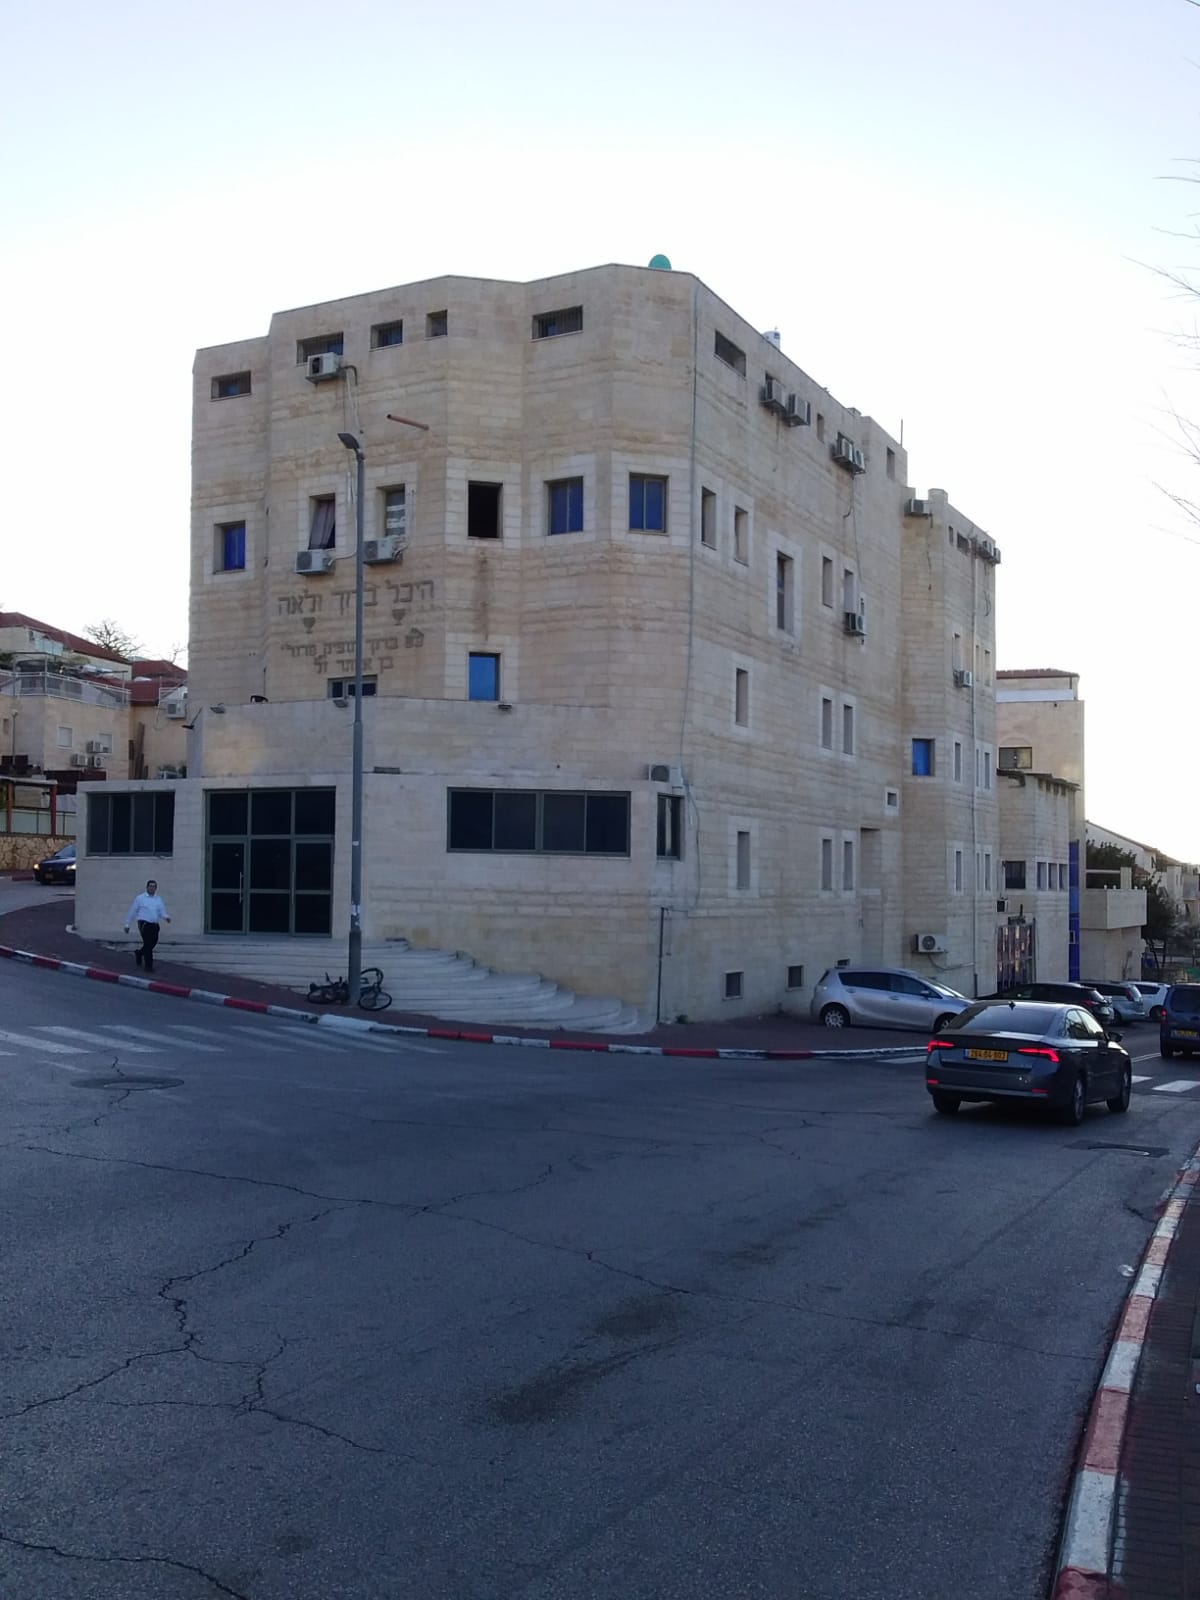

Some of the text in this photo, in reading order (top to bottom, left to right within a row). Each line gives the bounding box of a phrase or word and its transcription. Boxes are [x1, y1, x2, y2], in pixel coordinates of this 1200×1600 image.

[278, 579, 434, 615] היכל בוך ולאה
